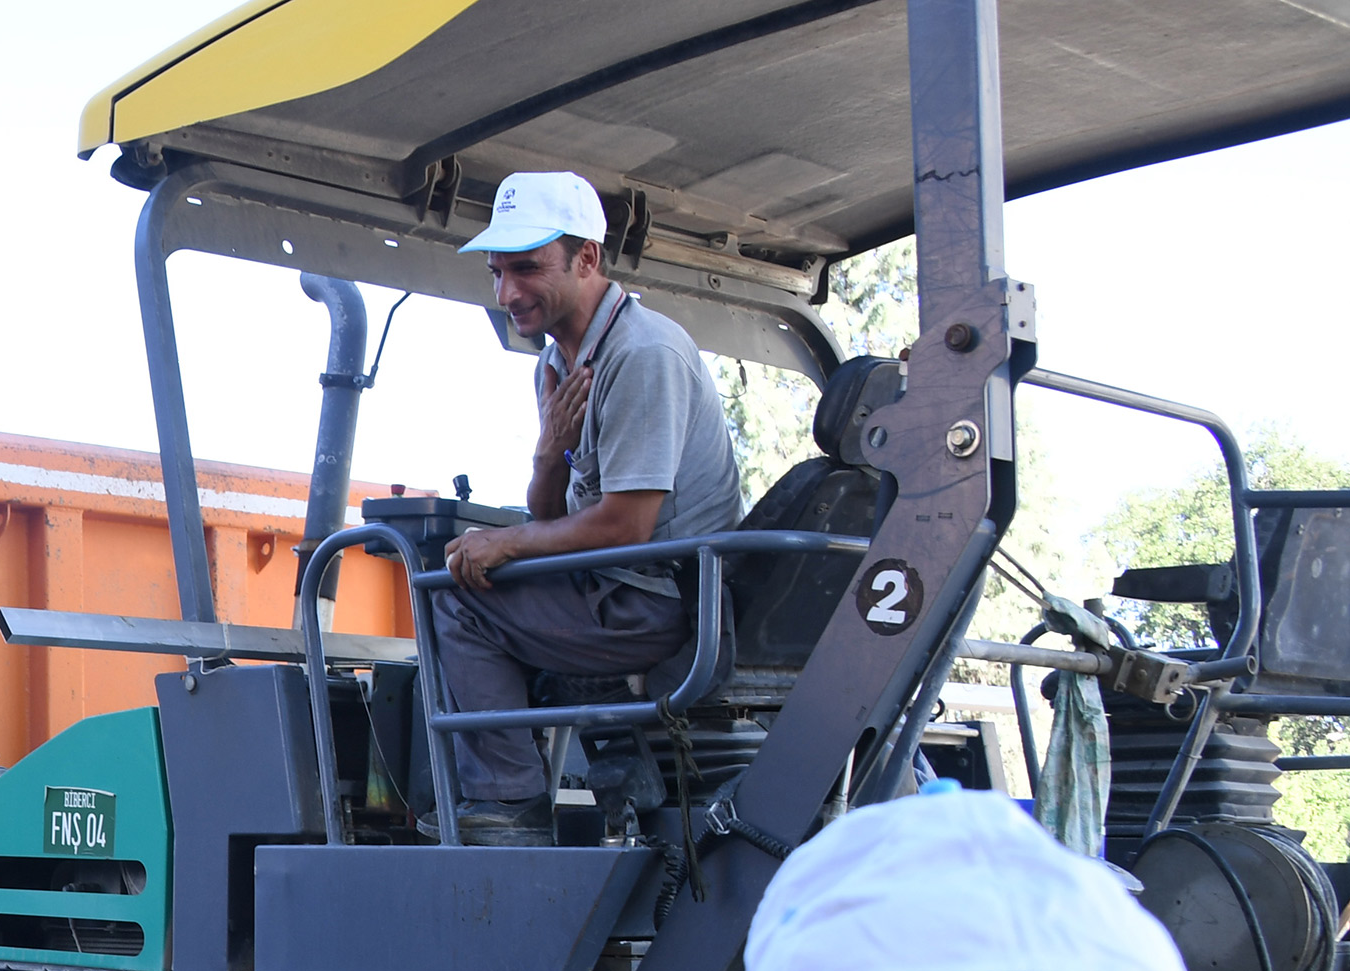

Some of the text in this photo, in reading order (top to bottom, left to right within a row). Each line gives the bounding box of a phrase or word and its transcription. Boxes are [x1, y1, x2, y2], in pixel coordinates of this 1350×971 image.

[866, 569, 908, 624] 2
[51, 811, 106, 855] FNŞ 04
